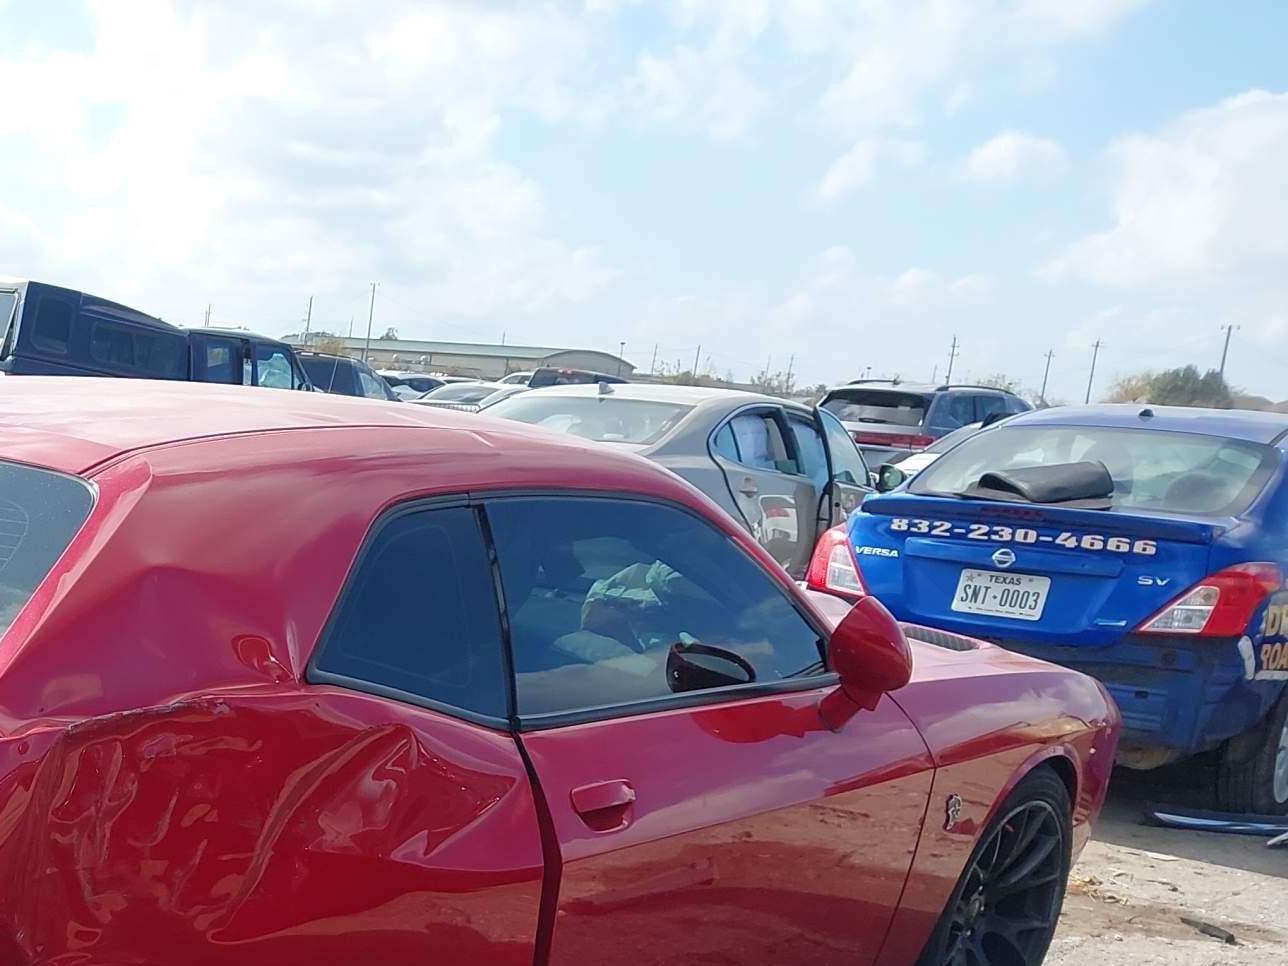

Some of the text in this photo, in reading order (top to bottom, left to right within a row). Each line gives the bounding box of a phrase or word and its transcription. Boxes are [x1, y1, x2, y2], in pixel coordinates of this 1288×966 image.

[889, 518, 1158, 555] 832-230-4666
[855, 545, 899, 558] VERSA
[988, 574, 1022, 586] TEXAS
[1137, 575, 1172, 586] SV
